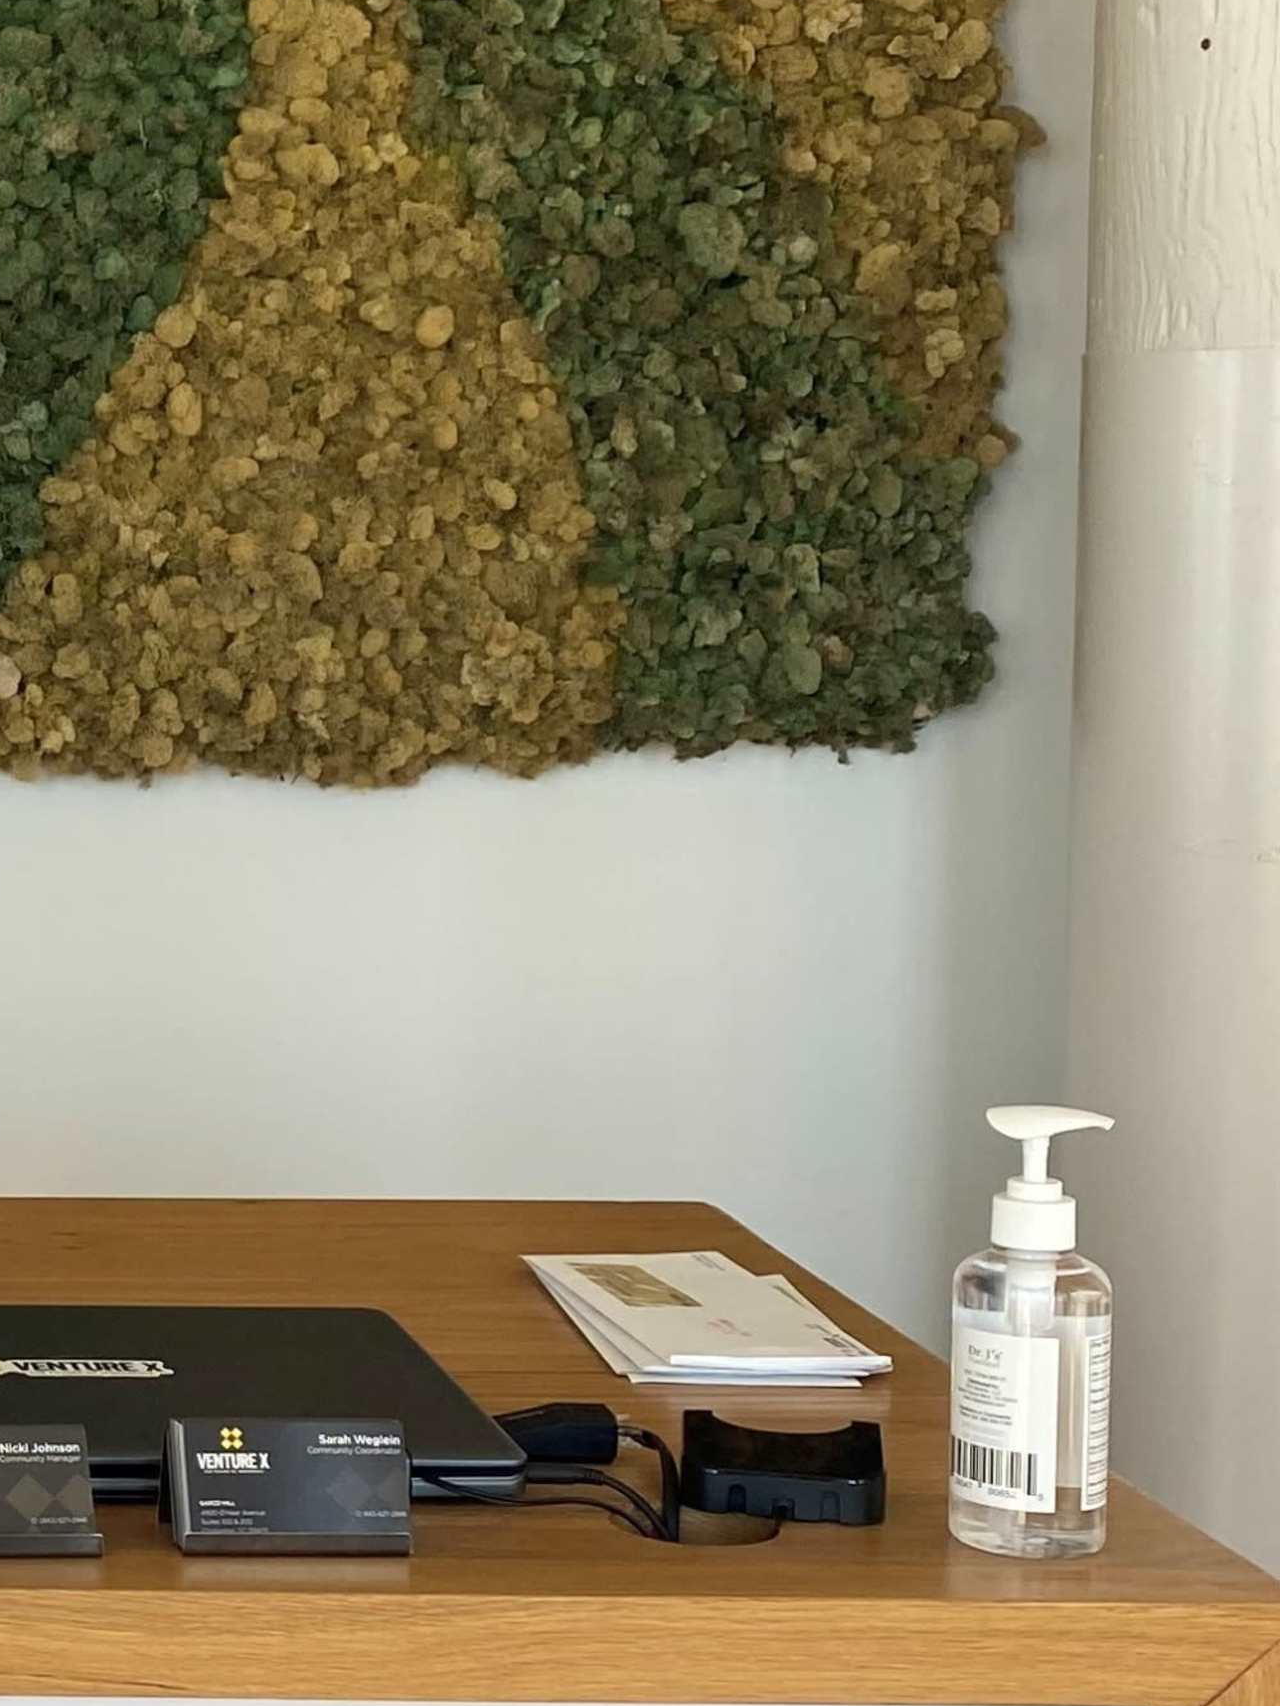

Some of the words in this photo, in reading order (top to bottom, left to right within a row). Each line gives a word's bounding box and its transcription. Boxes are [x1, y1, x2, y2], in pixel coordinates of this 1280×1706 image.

[12, 1361, 137, 1372] VENTURE
[141, 1362, 162, 1372] X
[318, 1434, 352, 1445] Sarah
[353, 1434, 401, 1447] Weglein
[0, 1442, 29, 1454] Nicki
[31, 1442, 80, 1454] Johnson
[306, 1445, 353, 1456] Community
[0, 1454, 45, 1464] Community
[47, 1455, 81, 1464] Manager
[196, 1453, 258, 1470] VENTURE
[259, 1453, 271, 1470] X
